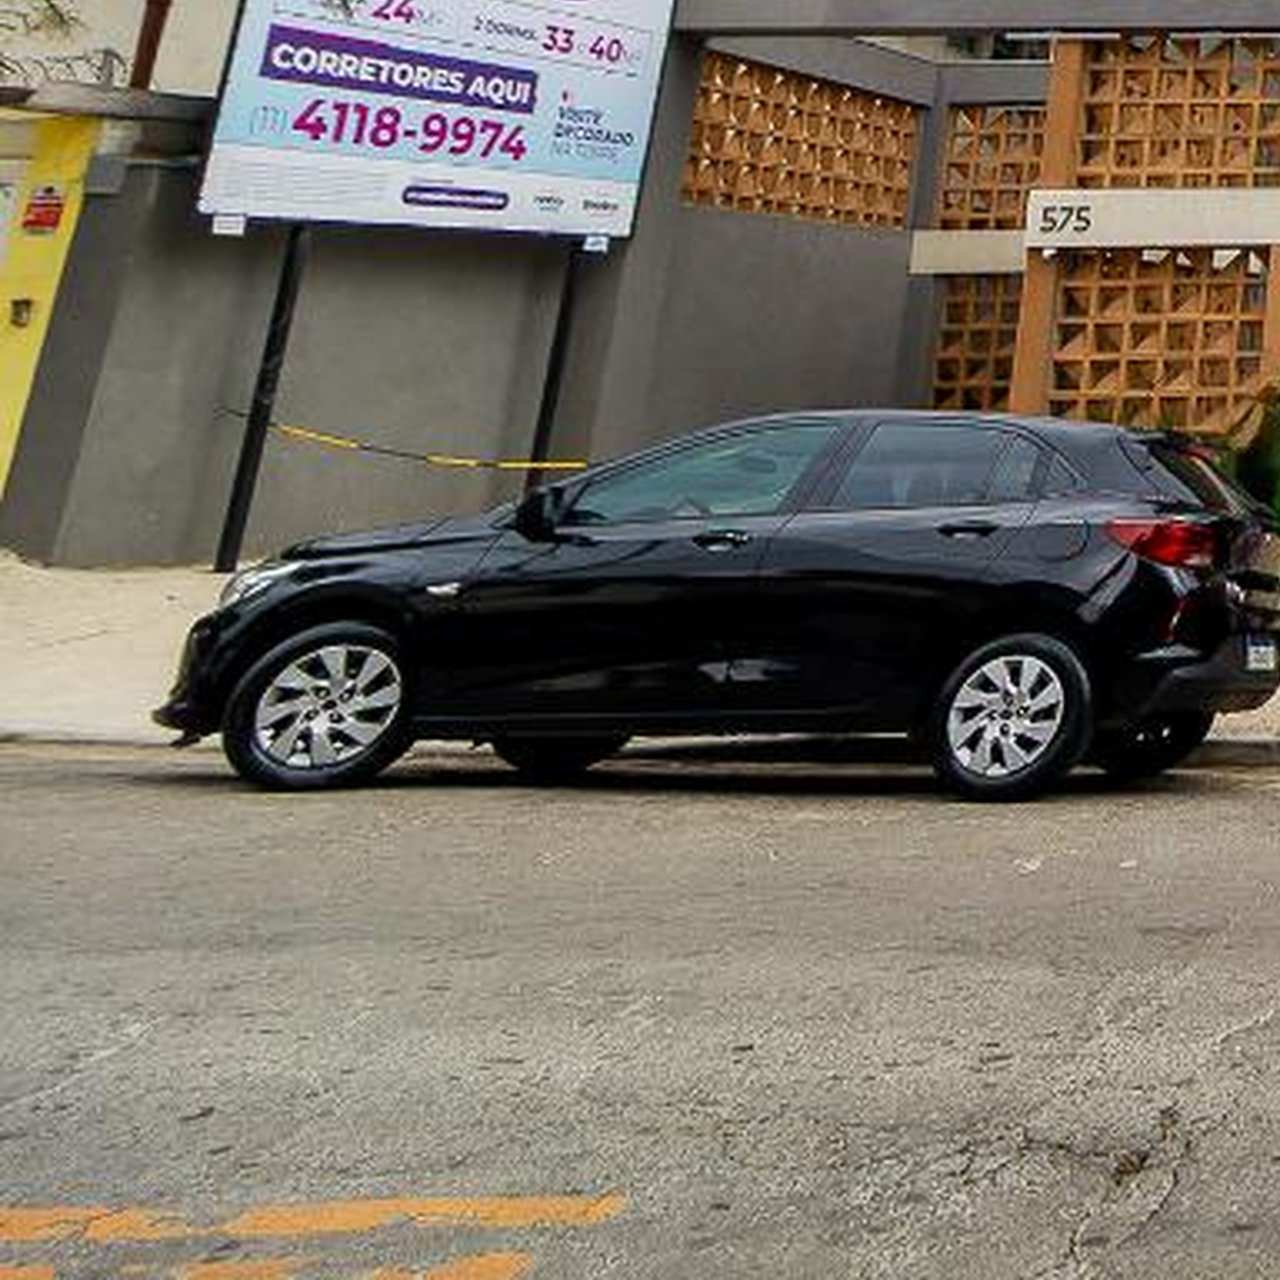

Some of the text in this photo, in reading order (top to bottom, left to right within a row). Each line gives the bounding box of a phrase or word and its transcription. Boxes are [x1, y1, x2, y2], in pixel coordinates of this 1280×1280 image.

[542, 25, 574, 53] 33
[589, 36, 623, 62] 40
[271, 43, 533, 106] CORRETORES AQUI
[292, 98, 528, 161] 4118-9974
[1040, 206, 1091, 233] 575
